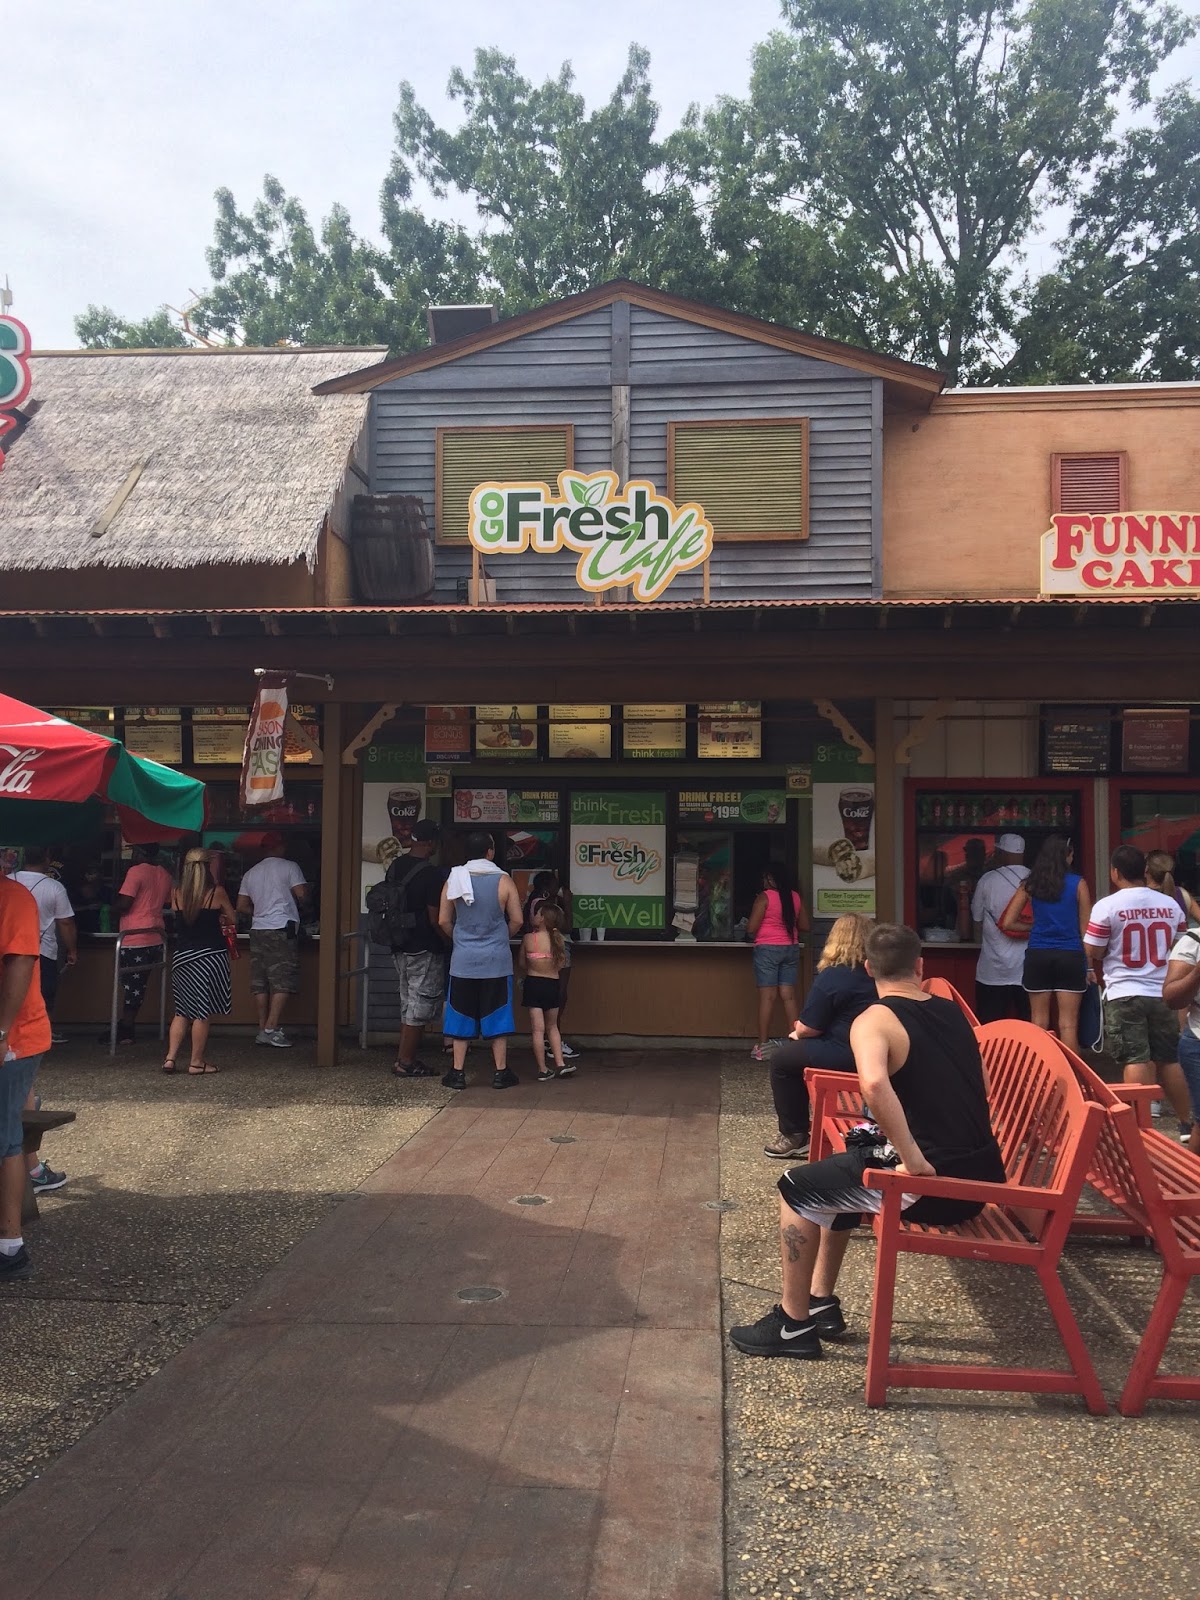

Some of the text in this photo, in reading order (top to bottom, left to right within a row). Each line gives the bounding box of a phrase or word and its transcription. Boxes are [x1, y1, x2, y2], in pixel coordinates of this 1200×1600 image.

[480, 491, 669, 543] GO Fresh
[588, 512, 704, 591] Cafe
[433, 730, 464, 739] BONUS
[368, 746, 377, 763] GO
[632, 749, 654, 758] think
[828, 746, 856, 762] Fre
[251, 751, 279, 776] PAS
[540, 791, 559, 800] FREE!
[679, 791, 741, 803] DRINK FREE!
[391, 806, 416, 817] Coke
[573, 797, 663, 824] think Fresh
[842, 807, 870, 818] Coke
[579, 844, 645, 863] GO Fresh
[843, 892, 871, 900] Together
[578, 896, 663, 926] eat Well
[1118, 908, 1175, 922] SUPREME
[1122, 921, 1172, 969] 00
